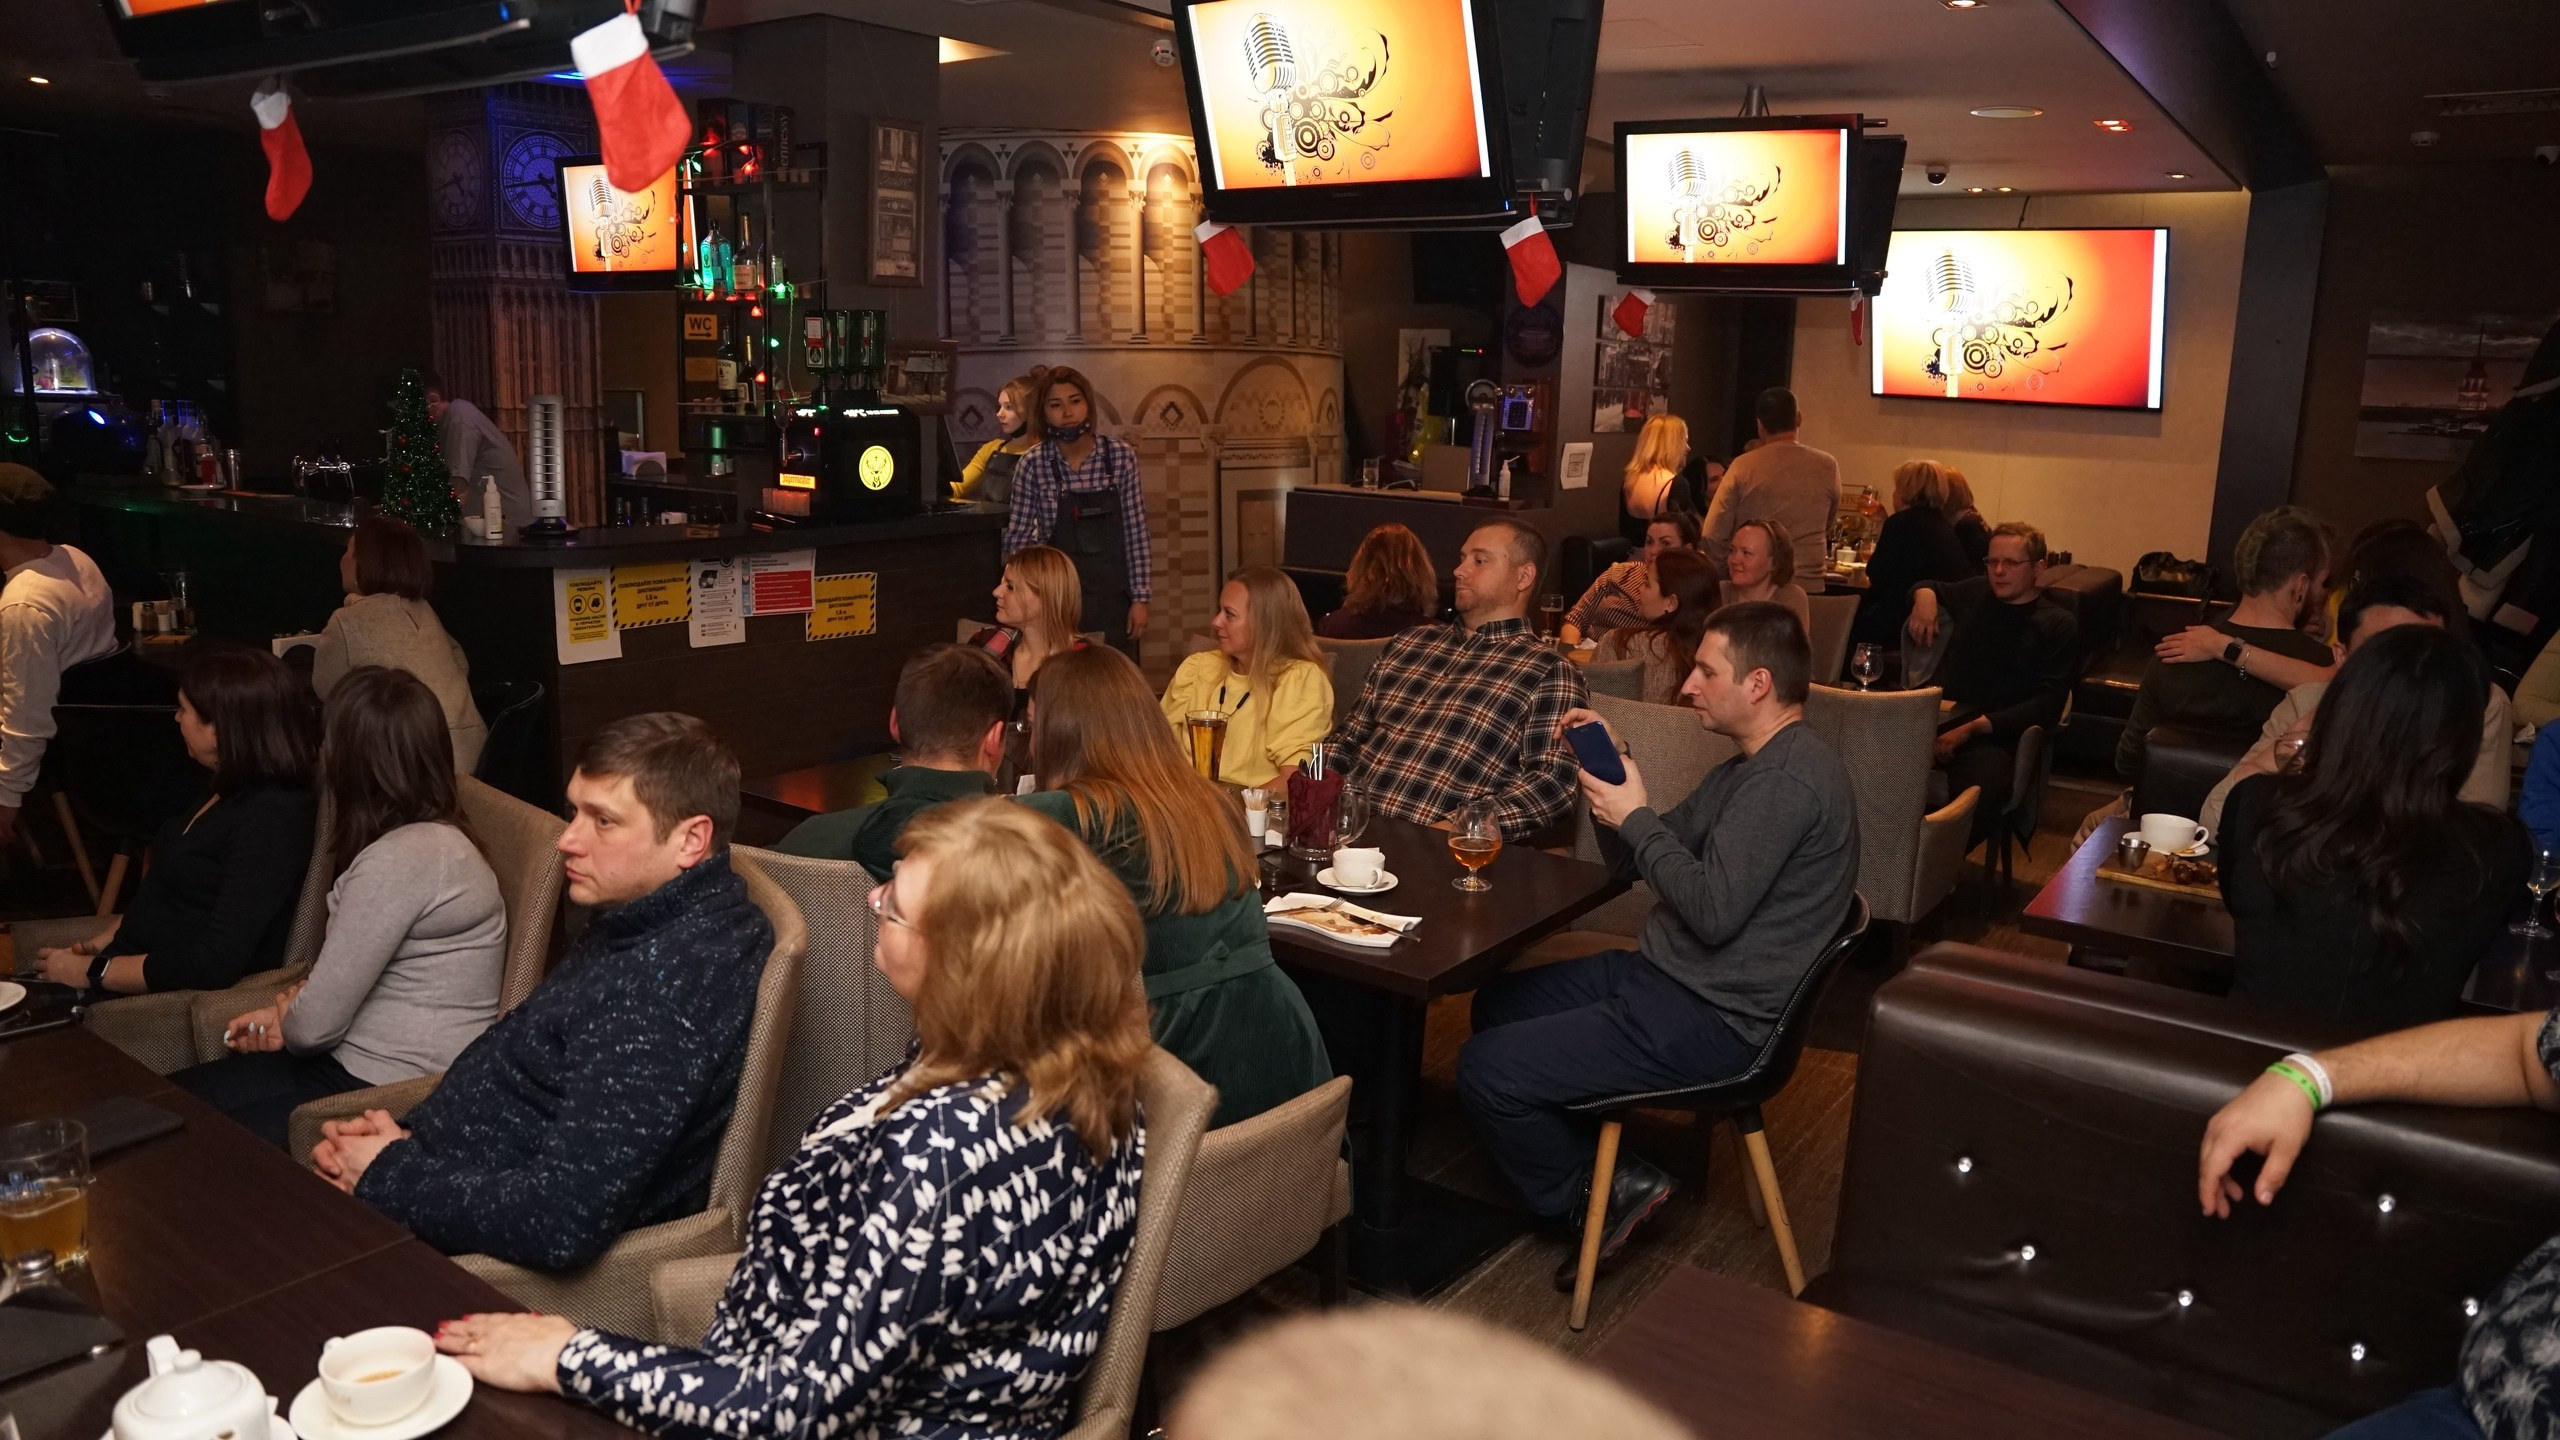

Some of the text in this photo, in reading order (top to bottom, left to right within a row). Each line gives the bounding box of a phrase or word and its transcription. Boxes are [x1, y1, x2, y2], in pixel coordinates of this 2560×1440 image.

[779, 113, 790, 169] ennessy
[689, 317, 712, 330] WC
[618, 577, 684, 589] СОБЛЮДАЙТЕ ПОЖАЛУЙСТА
[637, 586, 667, 594] ДИСТАНЦИЮ
